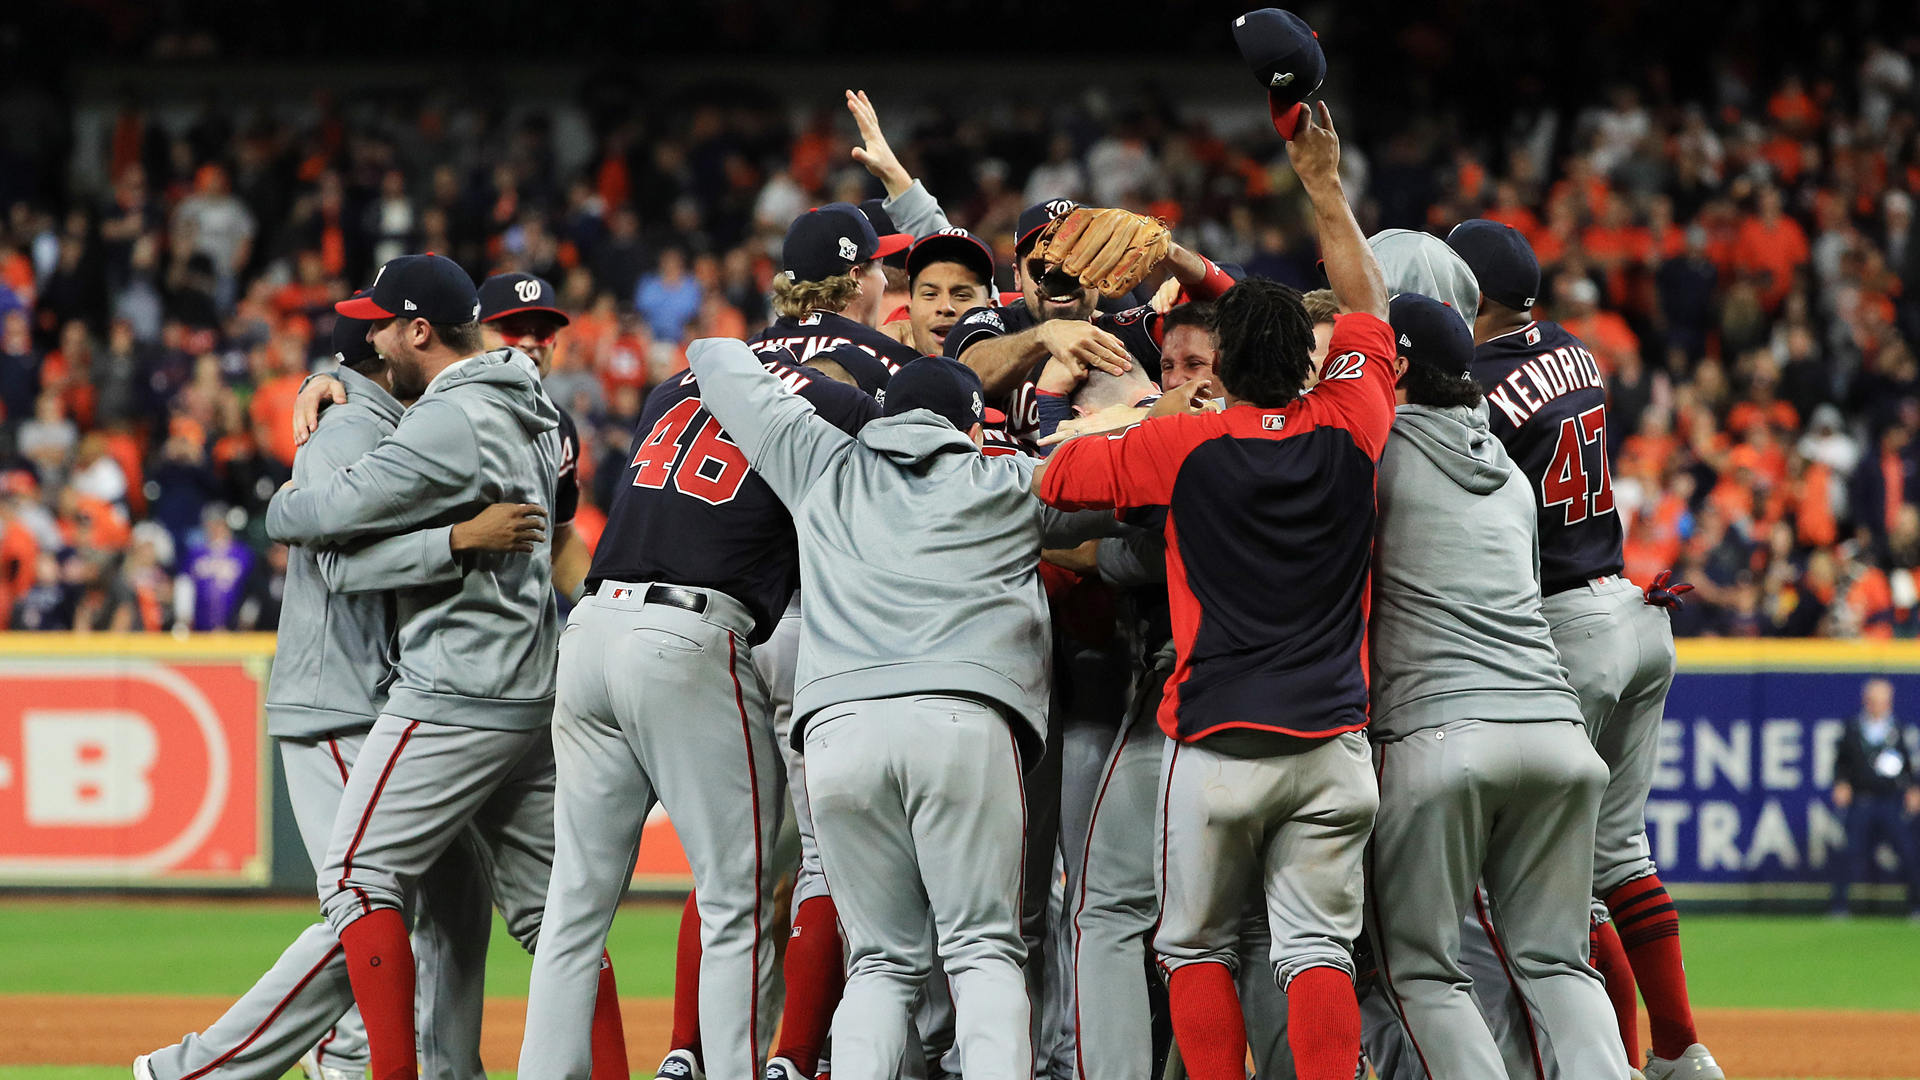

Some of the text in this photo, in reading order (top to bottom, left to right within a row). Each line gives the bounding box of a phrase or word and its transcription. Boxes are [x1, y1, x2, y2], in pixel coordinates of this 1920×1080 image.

[514, 279, 542, 302] W
[1011, 381, 1040, 430] Na
[630, 396, 751, 506] 46
[1541, 403, 1615, 526] 47
